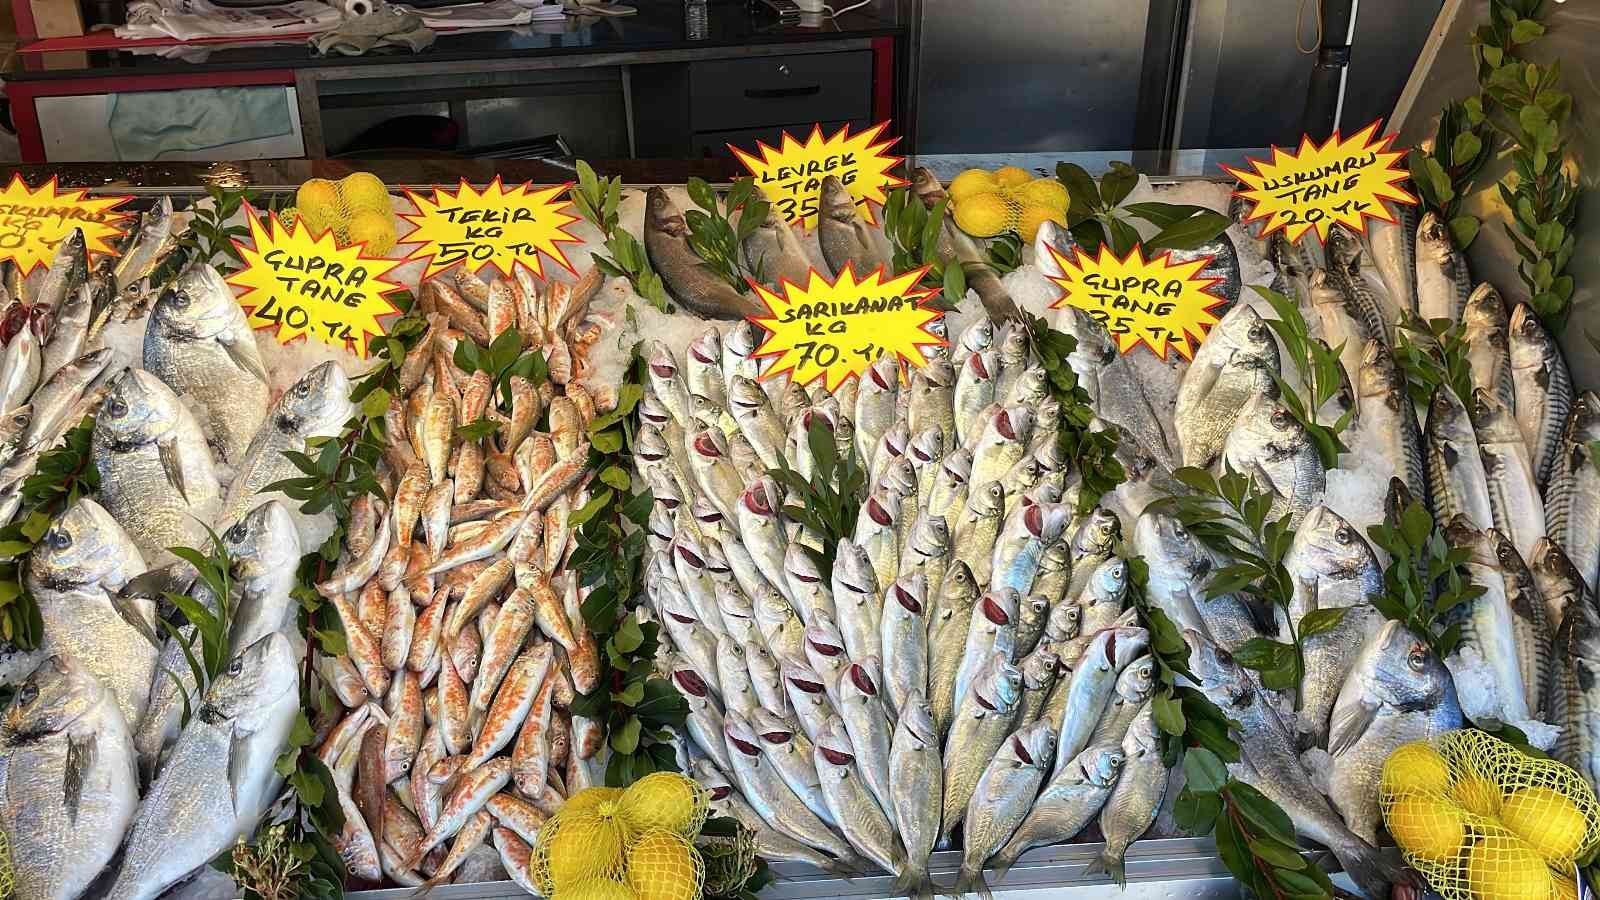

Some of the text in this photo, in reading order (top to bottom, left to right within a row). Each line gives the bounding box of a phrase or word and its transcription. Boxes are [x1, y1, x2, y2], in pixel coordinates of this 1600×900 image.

[762, 152, 857, 184] LEVREK
[1263, 152, 1377, 191] USKUMRU
[782, 169, 858, 195] TAE
[1275, 173, 1361, 205] TANE
[1280, 208, 1330, 225] 20.
[465, 226, 504, 239] KG
[432, 241, 502, 266] 50.
[263, 249, 369, 289] GUPRA
[276, 276, 367, 308] TANE
[1082, 273, 1184, 298] GUPRA
[255, 295, 315, 333] 40.
[779, 296, 923, 323] SARIKANAT
[1088, 293, 1177, 317] TANE
[805, 320, 848, 336] KG
[1145, 326, 1184, 343] TL
[794, 340, 848, 370] 70.
